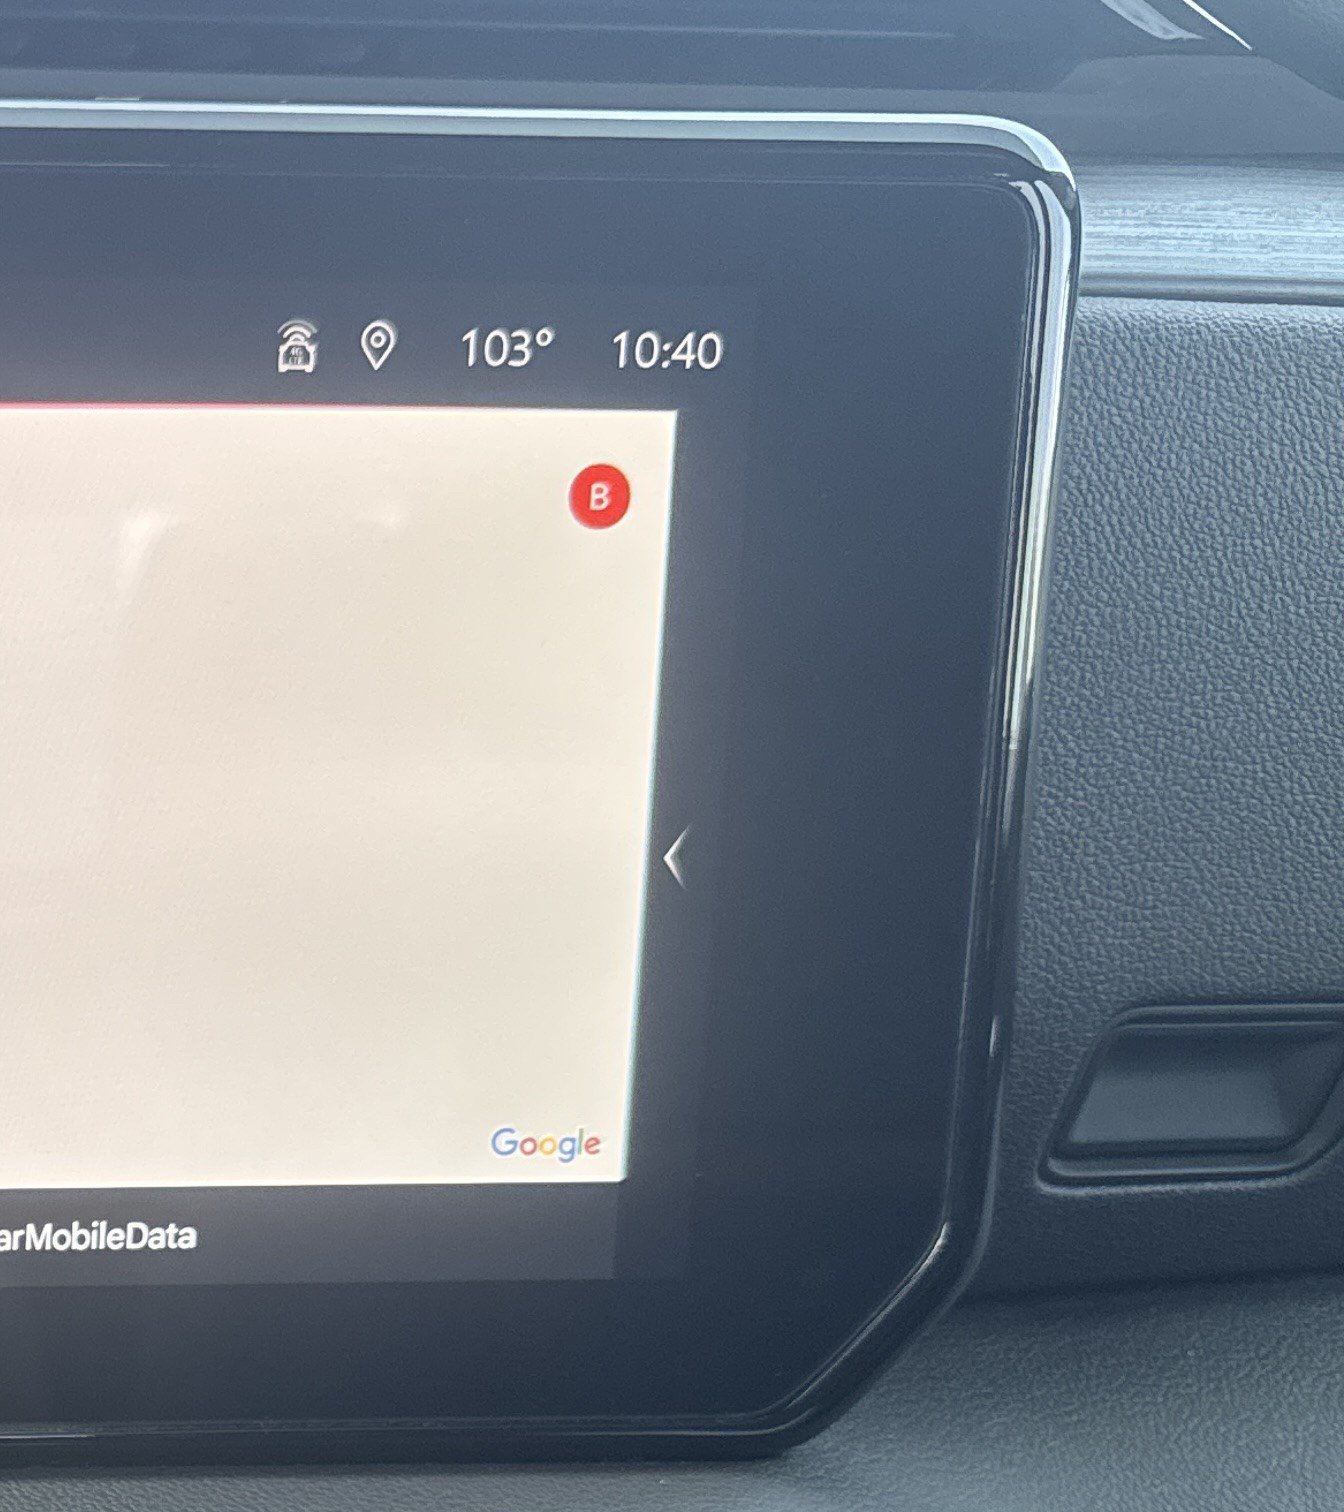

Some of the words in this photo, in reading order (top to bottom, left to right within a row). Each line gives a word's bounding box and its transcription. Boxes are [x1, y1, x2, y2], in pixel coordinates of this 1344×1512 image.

[462, 326, 556, 369] 103°
[613, 329, 723, 371] 10:40
[589, 483, 611, 510] B
[490, 1127, 602, 1164] Google
